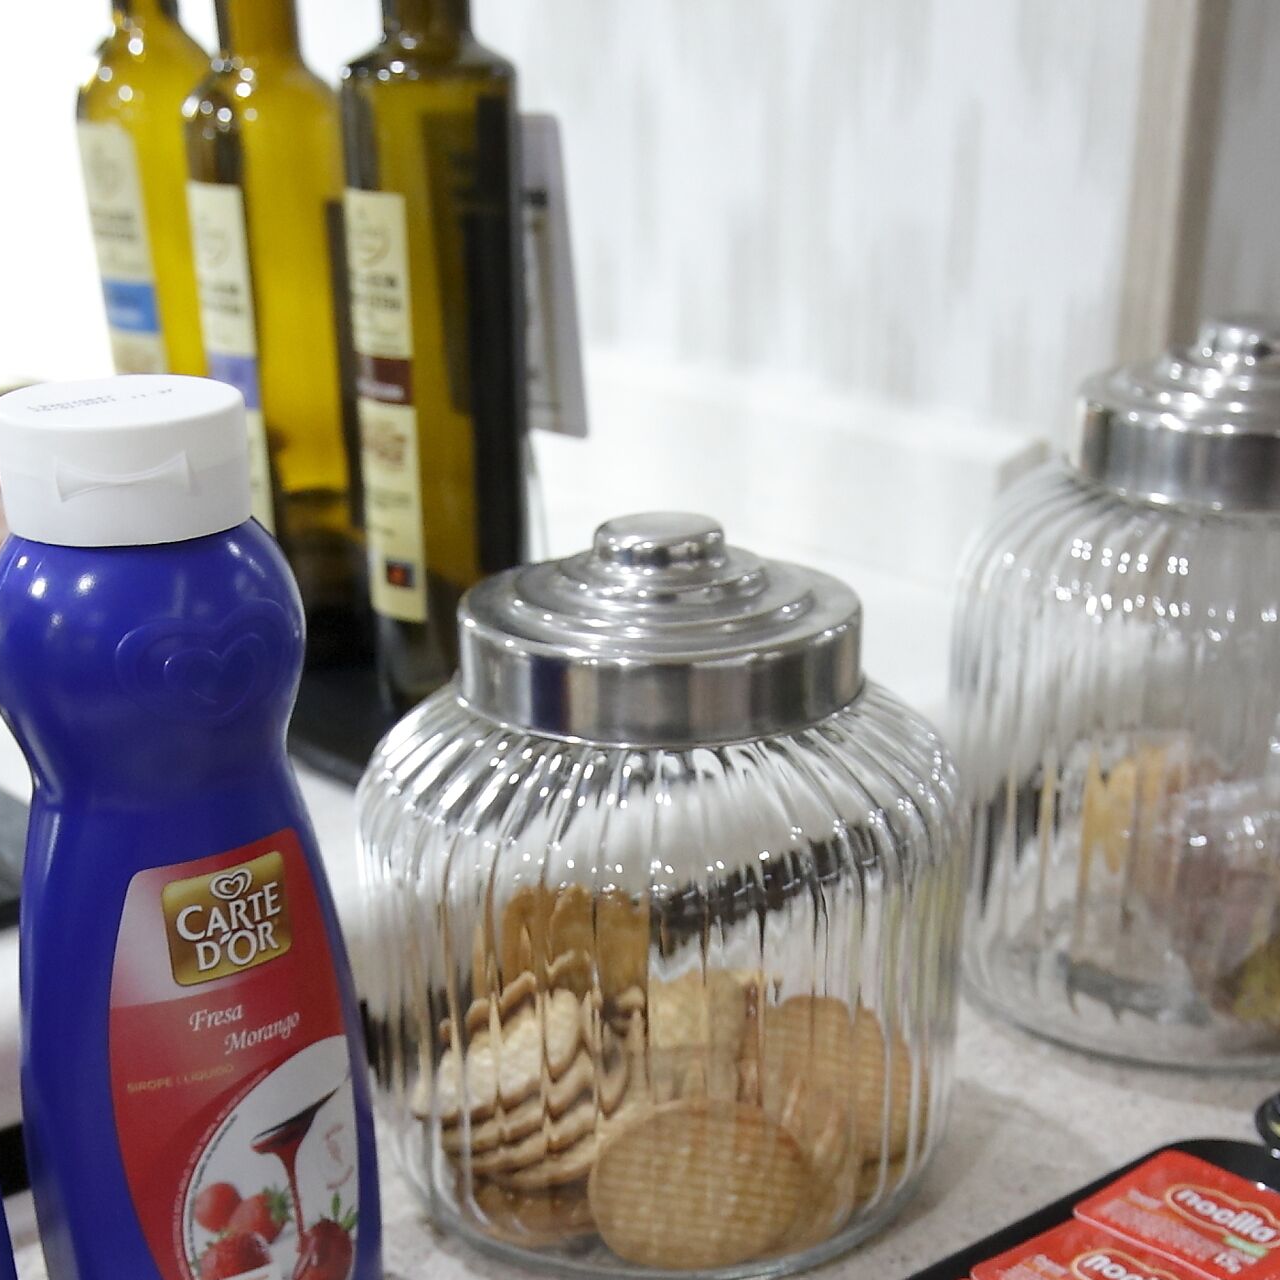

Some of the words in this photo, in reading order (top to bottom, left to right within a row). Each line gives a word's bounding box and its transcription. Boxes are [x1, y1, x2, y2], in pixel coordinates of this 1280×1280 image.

[176, 881, 282, 941] CARTE
[195, 920, 280, 972] D'OR
[189, 1004, 243, 1032] Fresa
[224, 1011, 300, 1055] Morango
[1175, 1188, 1279, 1243] nocilla
